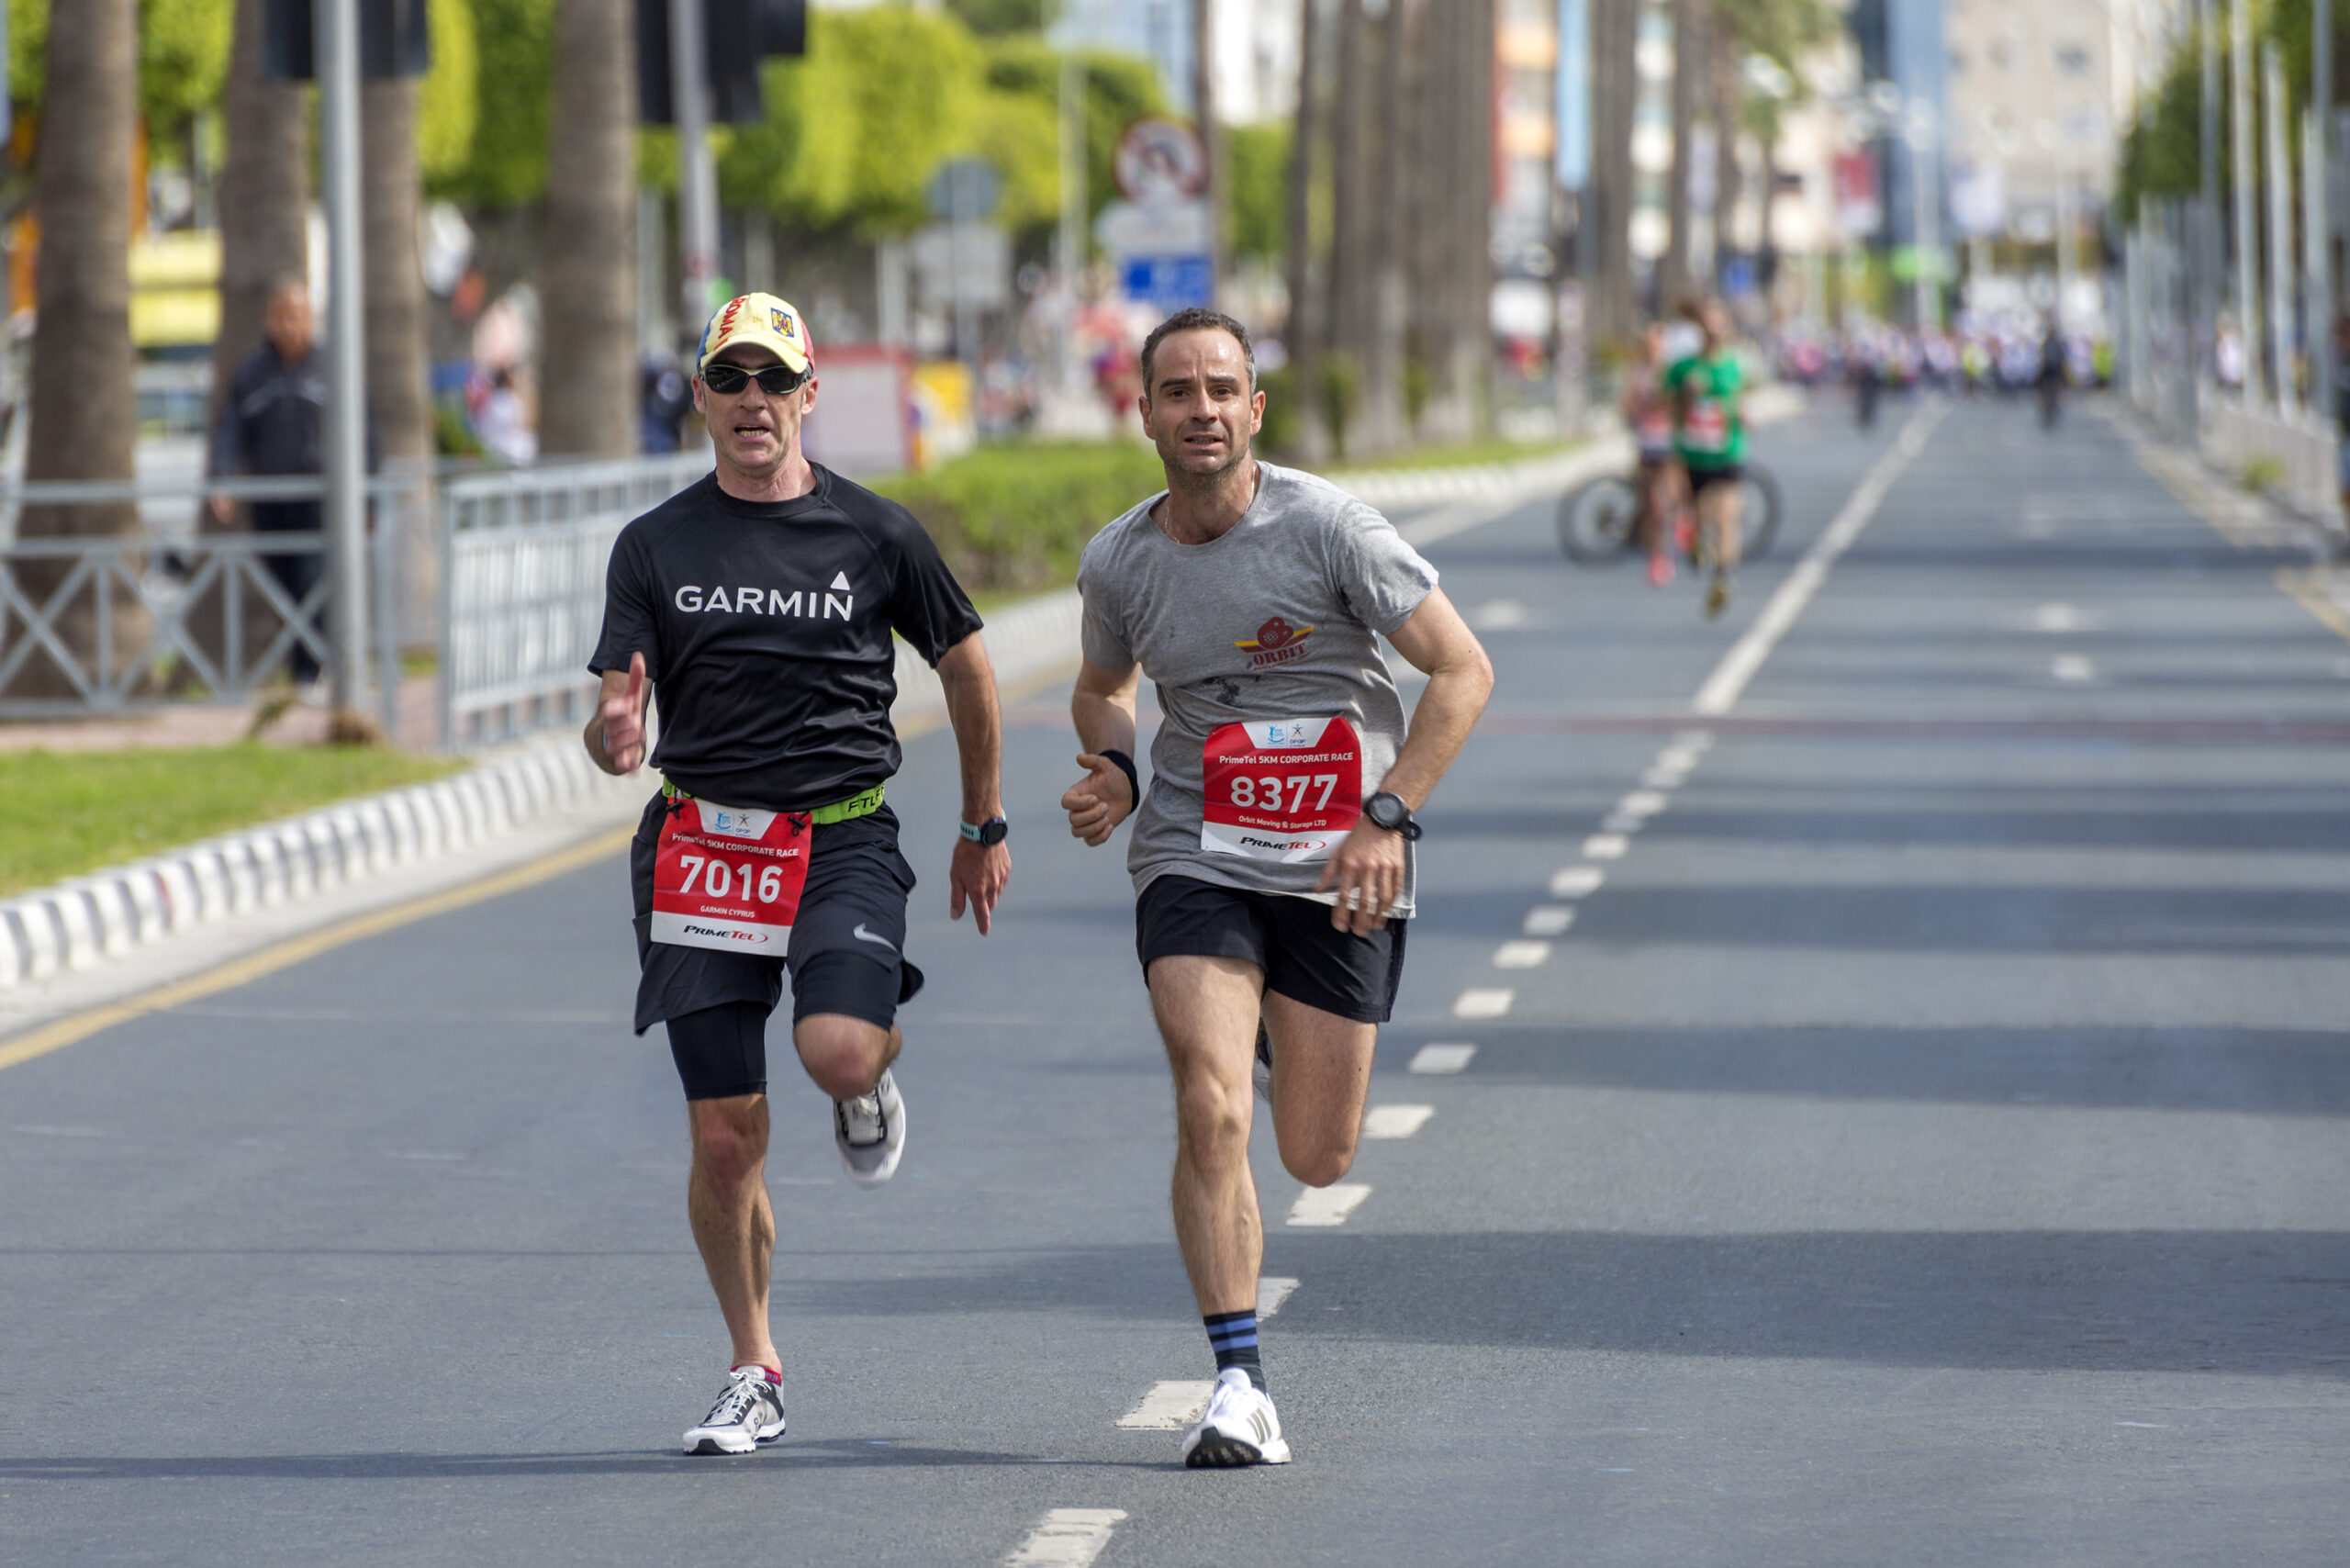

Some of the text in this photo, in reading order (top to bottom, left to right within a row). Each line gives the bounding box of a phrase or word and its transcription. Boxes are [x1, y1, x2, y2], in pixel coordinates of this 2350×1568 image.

[675, 585, 854, 622] GARMIN
[1252, 643, 1306, 666] ORBIT
[1219, 752, 1353, 764] PrimeTel 5KM CORPORATE RACE
[1230, 774, 1338, 814] 8377
[1238, 815, 1256, 823] Orbit
[1257, 818, 1281, 829] Moving
[672, 833, 800, 857] PrimeTel 5KM CORPORATE RACE
[679, 855, 783, 904] 7016
[700, 905, 755, 919] GARMIN CYPRUS
